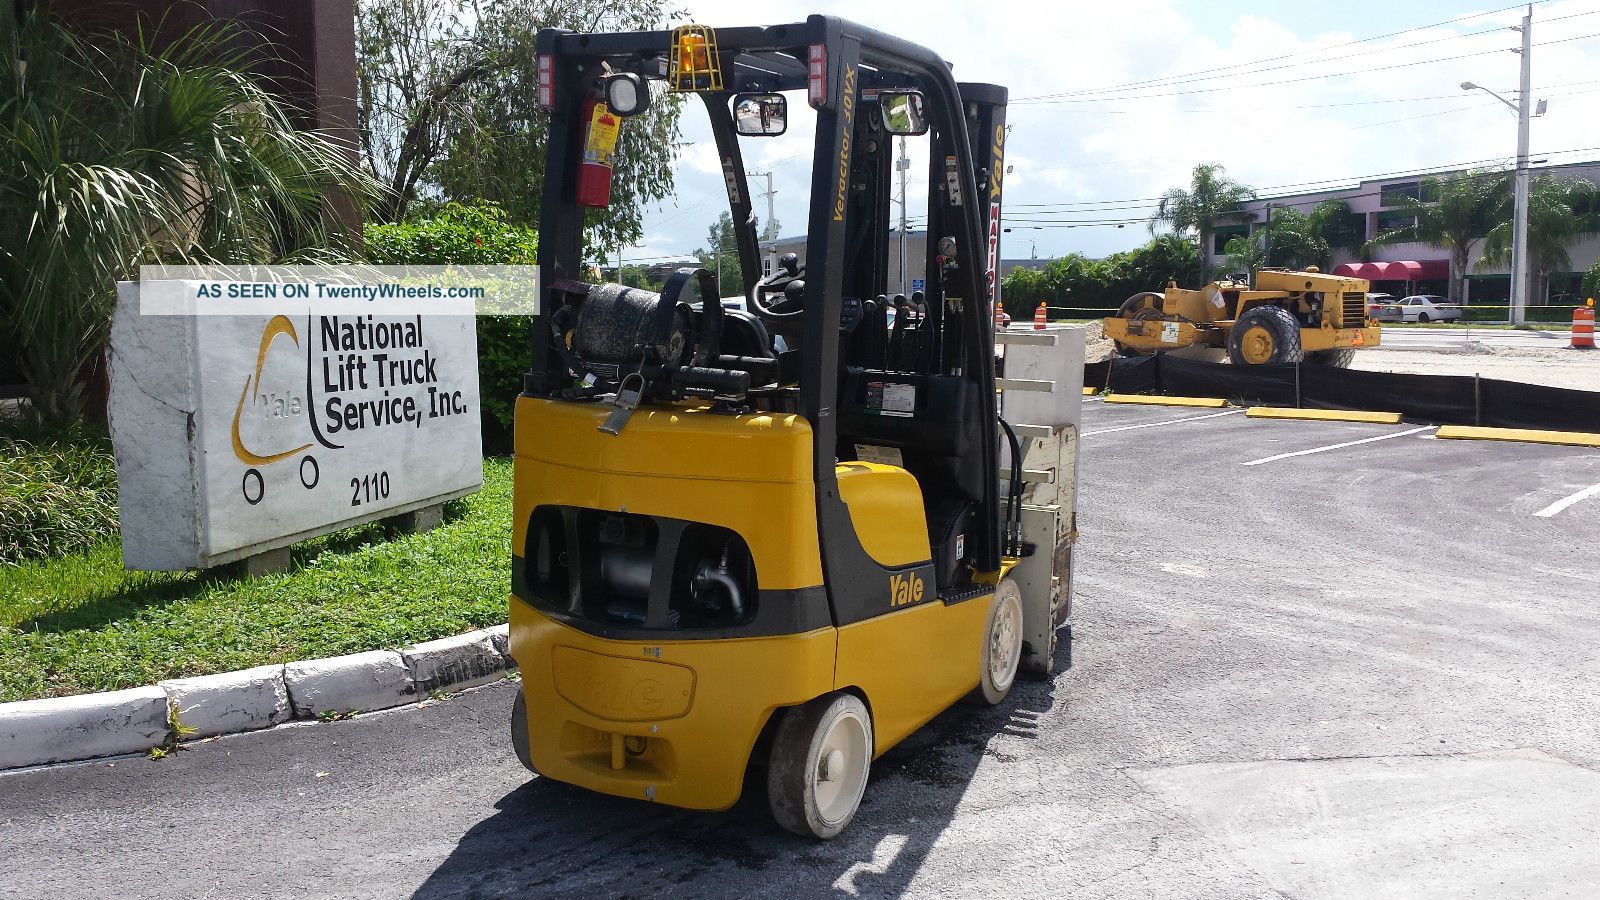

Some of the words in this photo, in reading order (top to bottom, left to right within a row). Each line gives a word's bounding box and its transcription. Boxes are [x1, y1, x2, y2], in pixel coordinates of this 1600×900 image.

[833, 126, 850, 221] Veracitor
[990, 124, 1004, 199] Yale
[320, 314, 423, 352] National
[322, 353, 368, 393] Lift
[372, 349, 438, 388] Truck
[261, 390, 301, 420] Yale
[325, 390, 422, 434] Service,
[427, 386, 467, 418] Inc.
[350, 471, 390, 507] 2110
[889, 571, 924, 607] Yale
